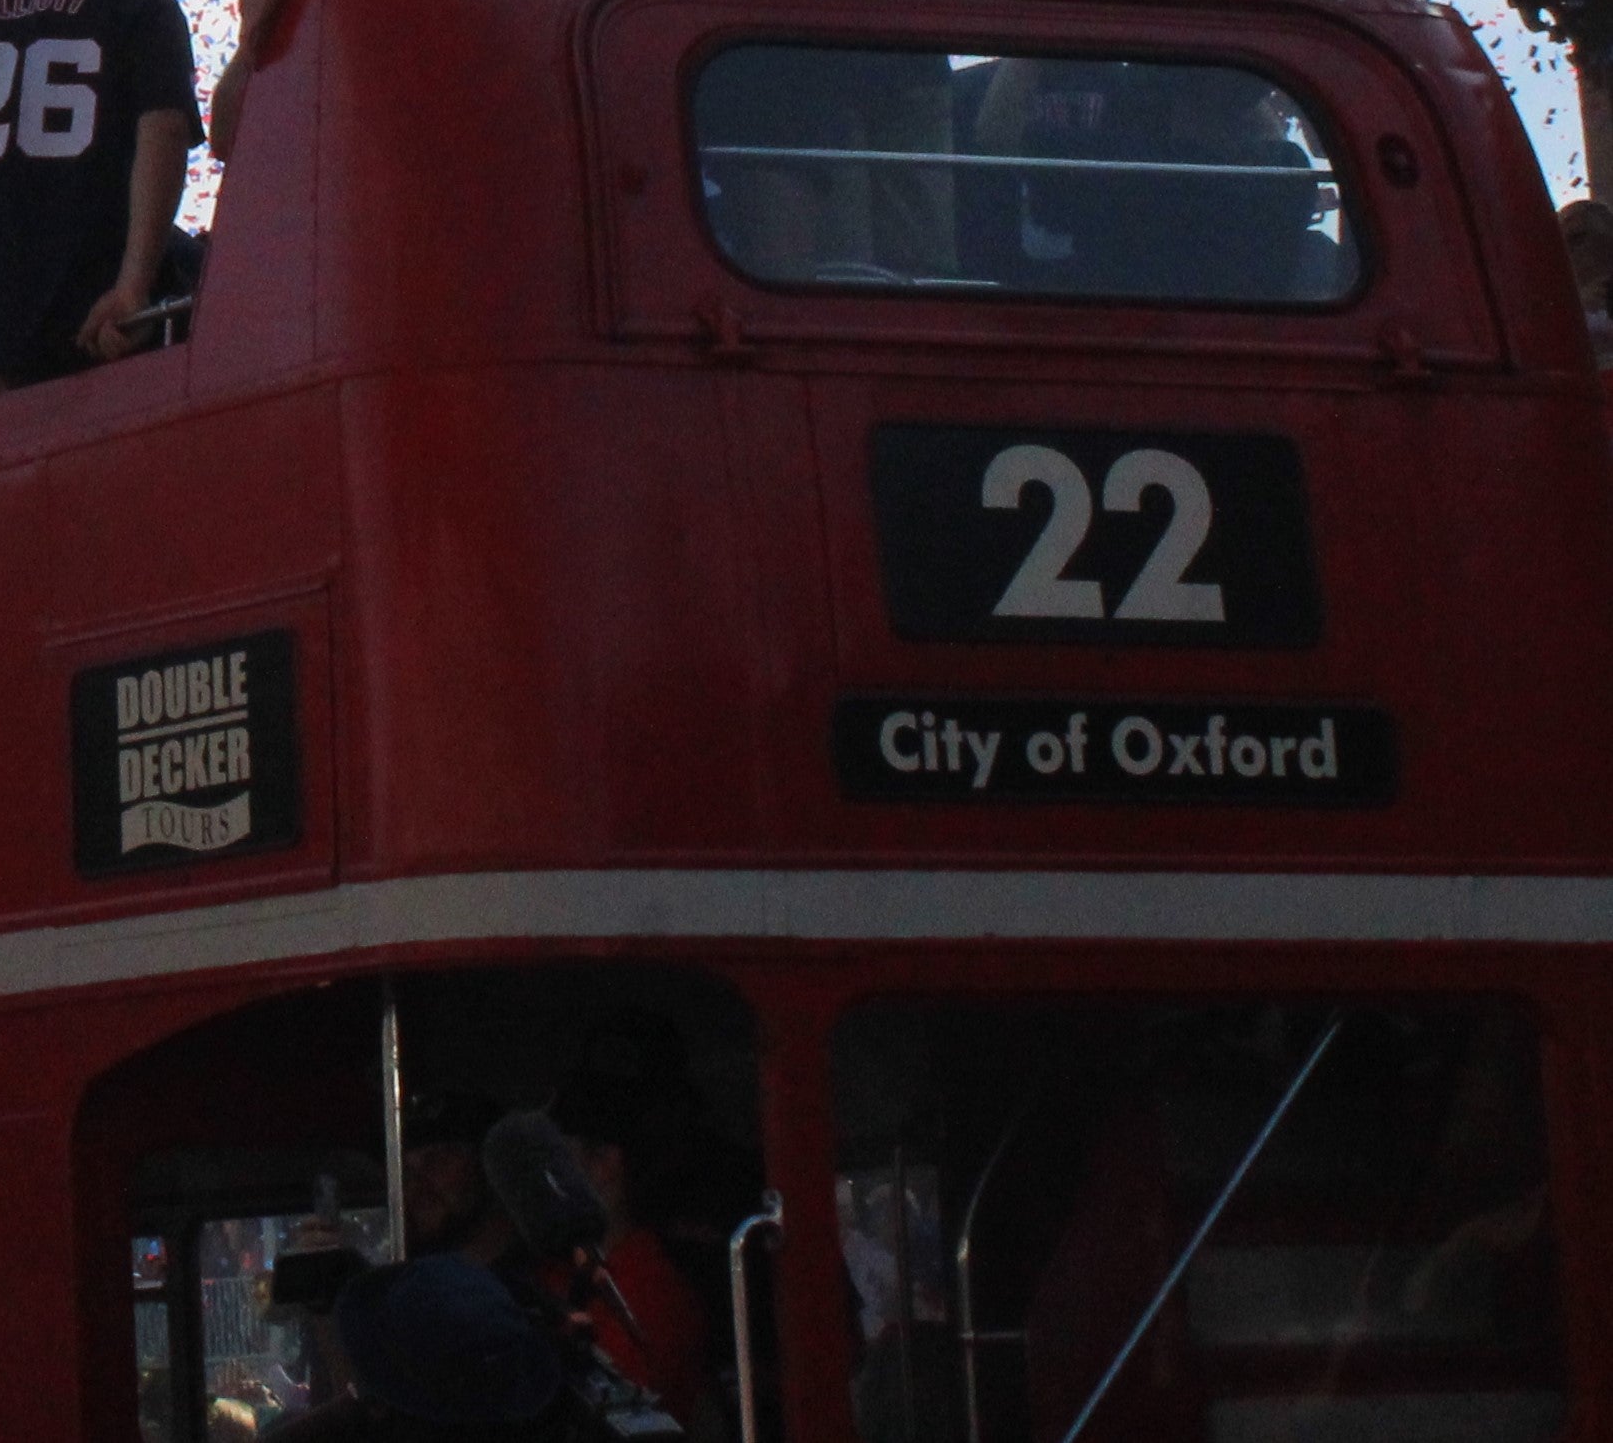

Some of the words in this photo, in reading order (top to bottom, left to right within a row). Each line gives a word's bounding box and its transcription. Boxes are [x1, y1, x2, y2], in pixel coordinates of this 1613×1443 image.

[981, 443, 1227, 623] 22
[116, 650, 248, 730] DOUBLE
[118, 726, 252, 804] DECKER
[878, 710, 1002, 788] City
[1025, 711, 1088, 774] of
[1110, 713, 1340, 780] Oxford
[140, 806, 232, 846] TOURS
